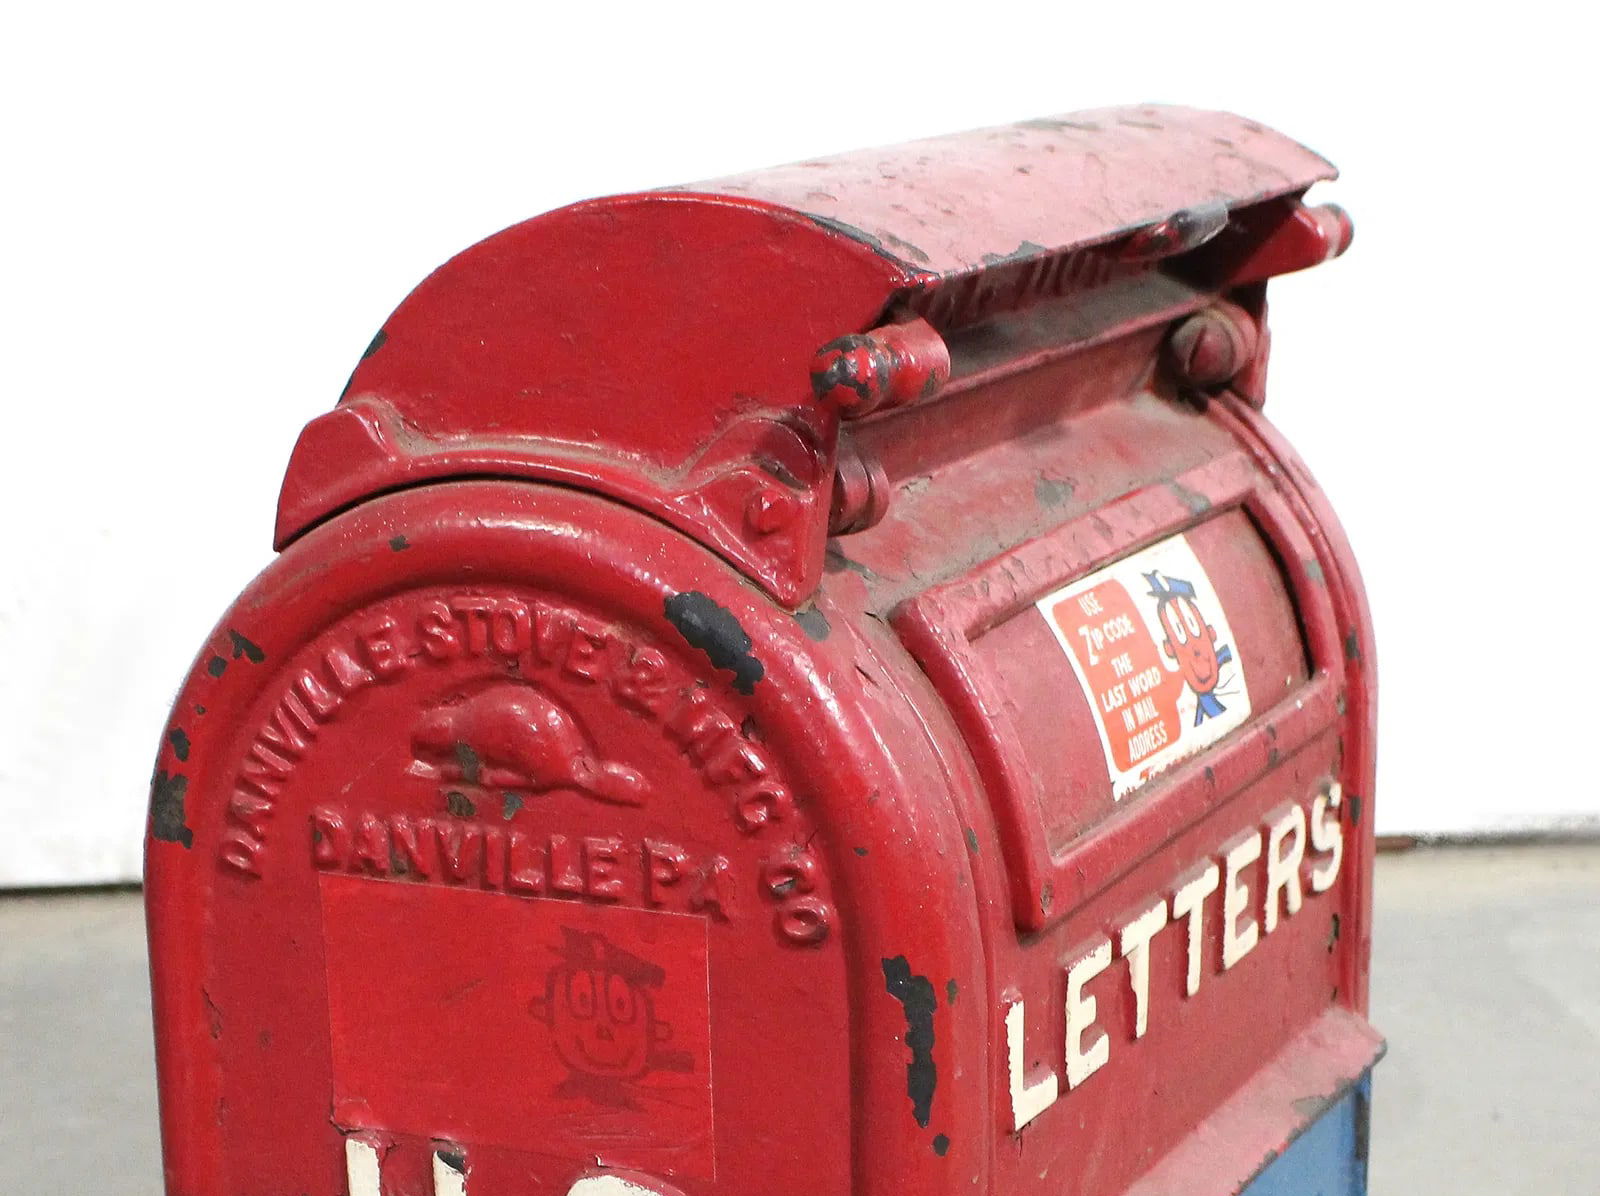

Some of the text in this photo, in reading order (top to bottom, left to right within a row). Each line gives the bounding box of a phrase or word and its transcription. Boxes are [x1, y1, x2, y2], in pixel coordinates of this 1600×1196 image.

[1079, 593, 1103, 616] USE
[1079, 614, 1135, 665] ZIP CODE
[1112, 653, 1134, 677] THE
[1102, 668, 1160, 712] LAST WORD
[218, 612, 408, 880] DANVILLE
[417, 593, 610, 683] STOVE
[1122, 698, 1159, 732] IN MAIL
[1129, 723, 1168, 762] ADDRESS
[311, 805, 630, 899] DANVILLE
[1003, 780, 1343, 1131] LETTERS
